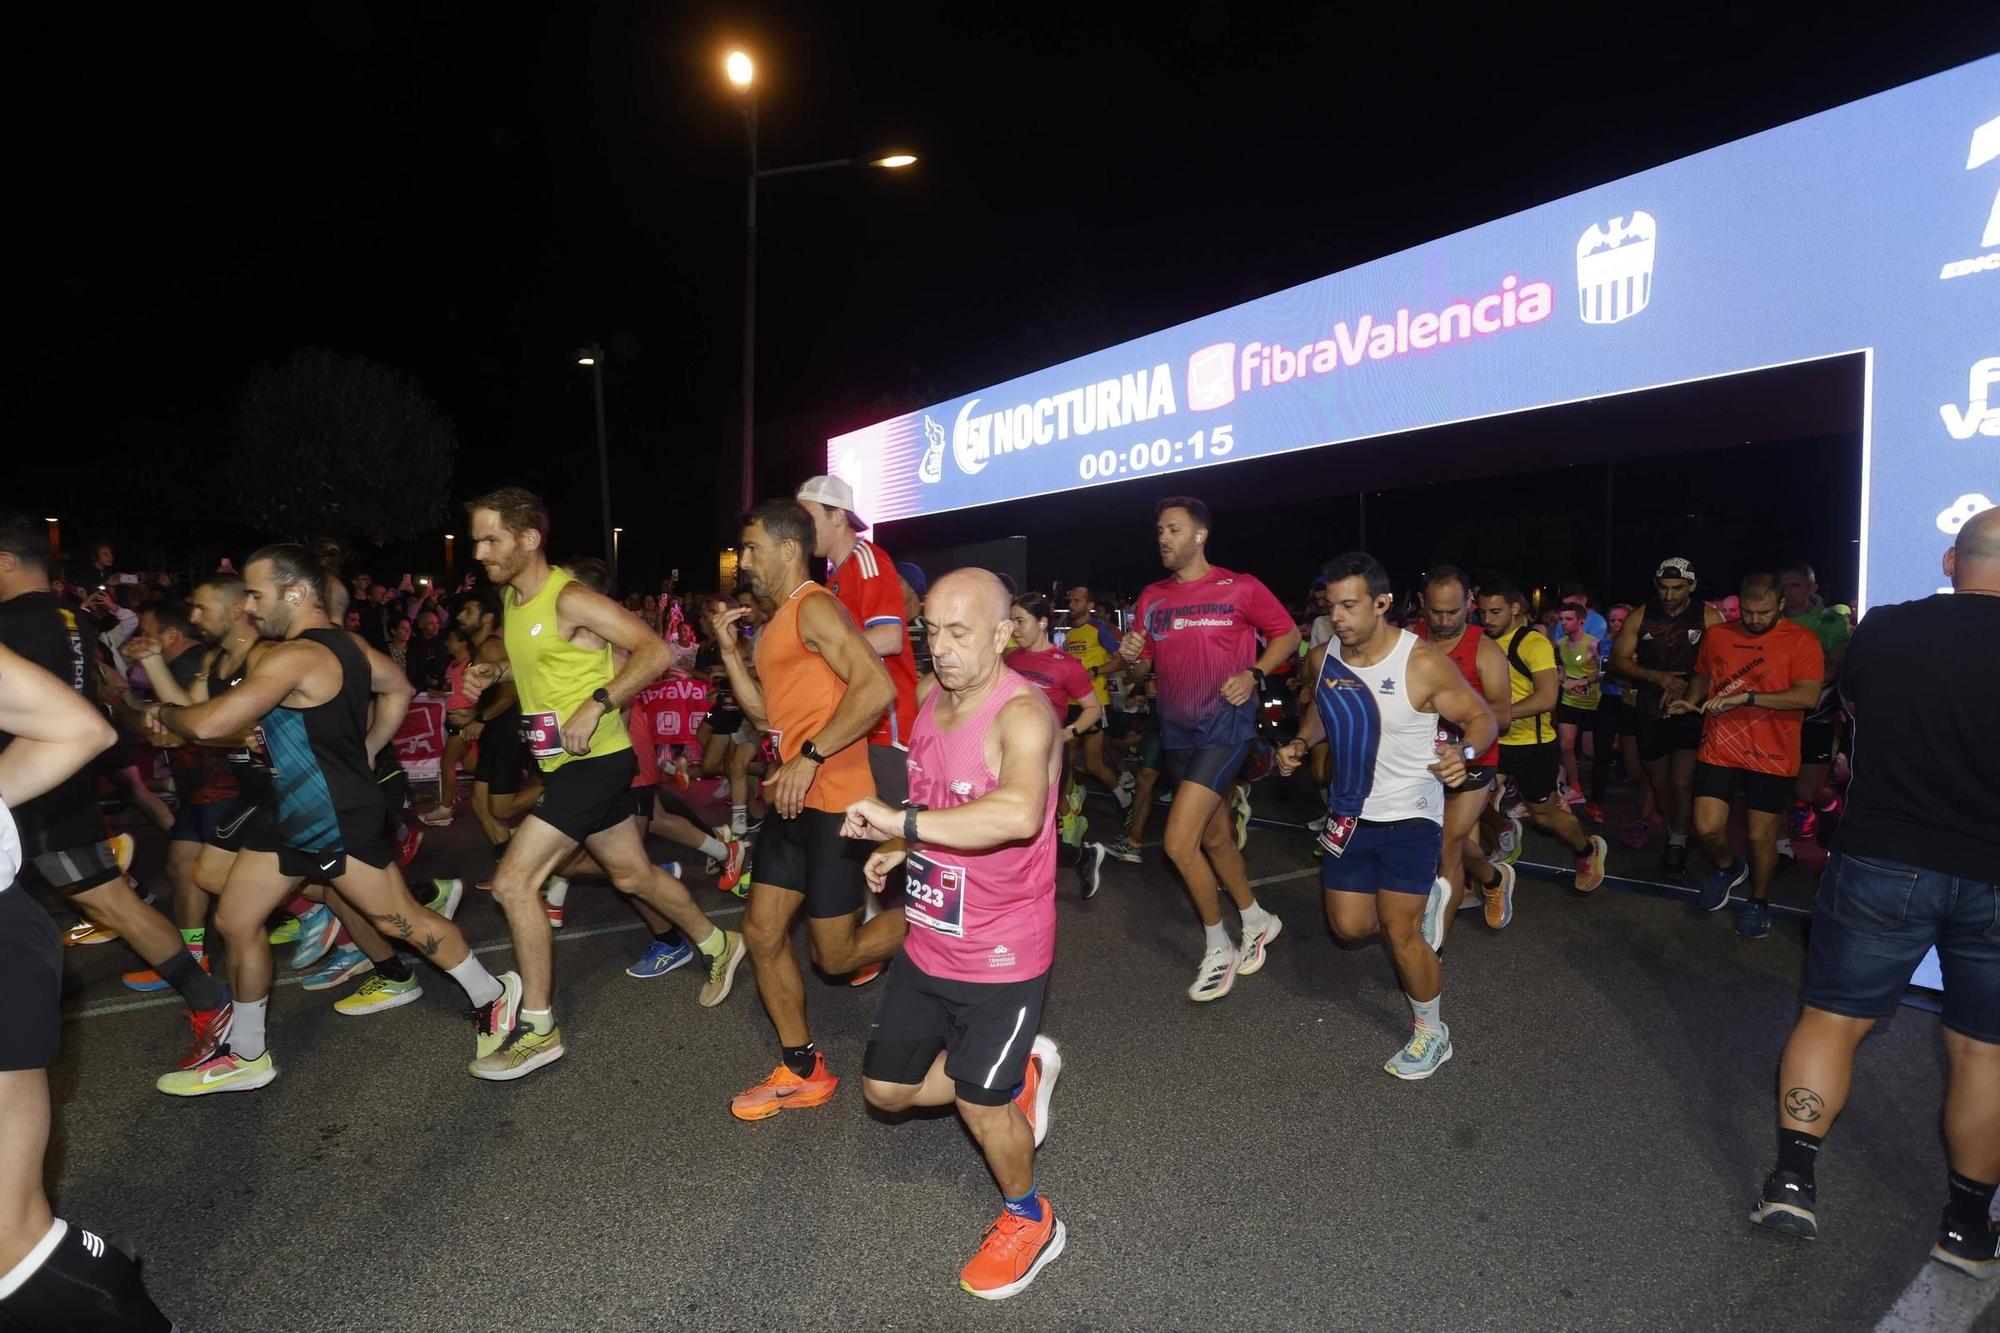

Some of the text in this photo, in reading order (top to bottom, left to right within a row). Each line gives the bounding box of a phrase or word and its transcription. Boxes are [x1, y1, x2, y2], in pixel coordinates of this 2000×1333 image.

[994, 362, 1177, 456] NOCTURNA
[1080, 425, 1234, 480] 00:00:15
[1174, 603, 1234, 617] NOCTURNA
